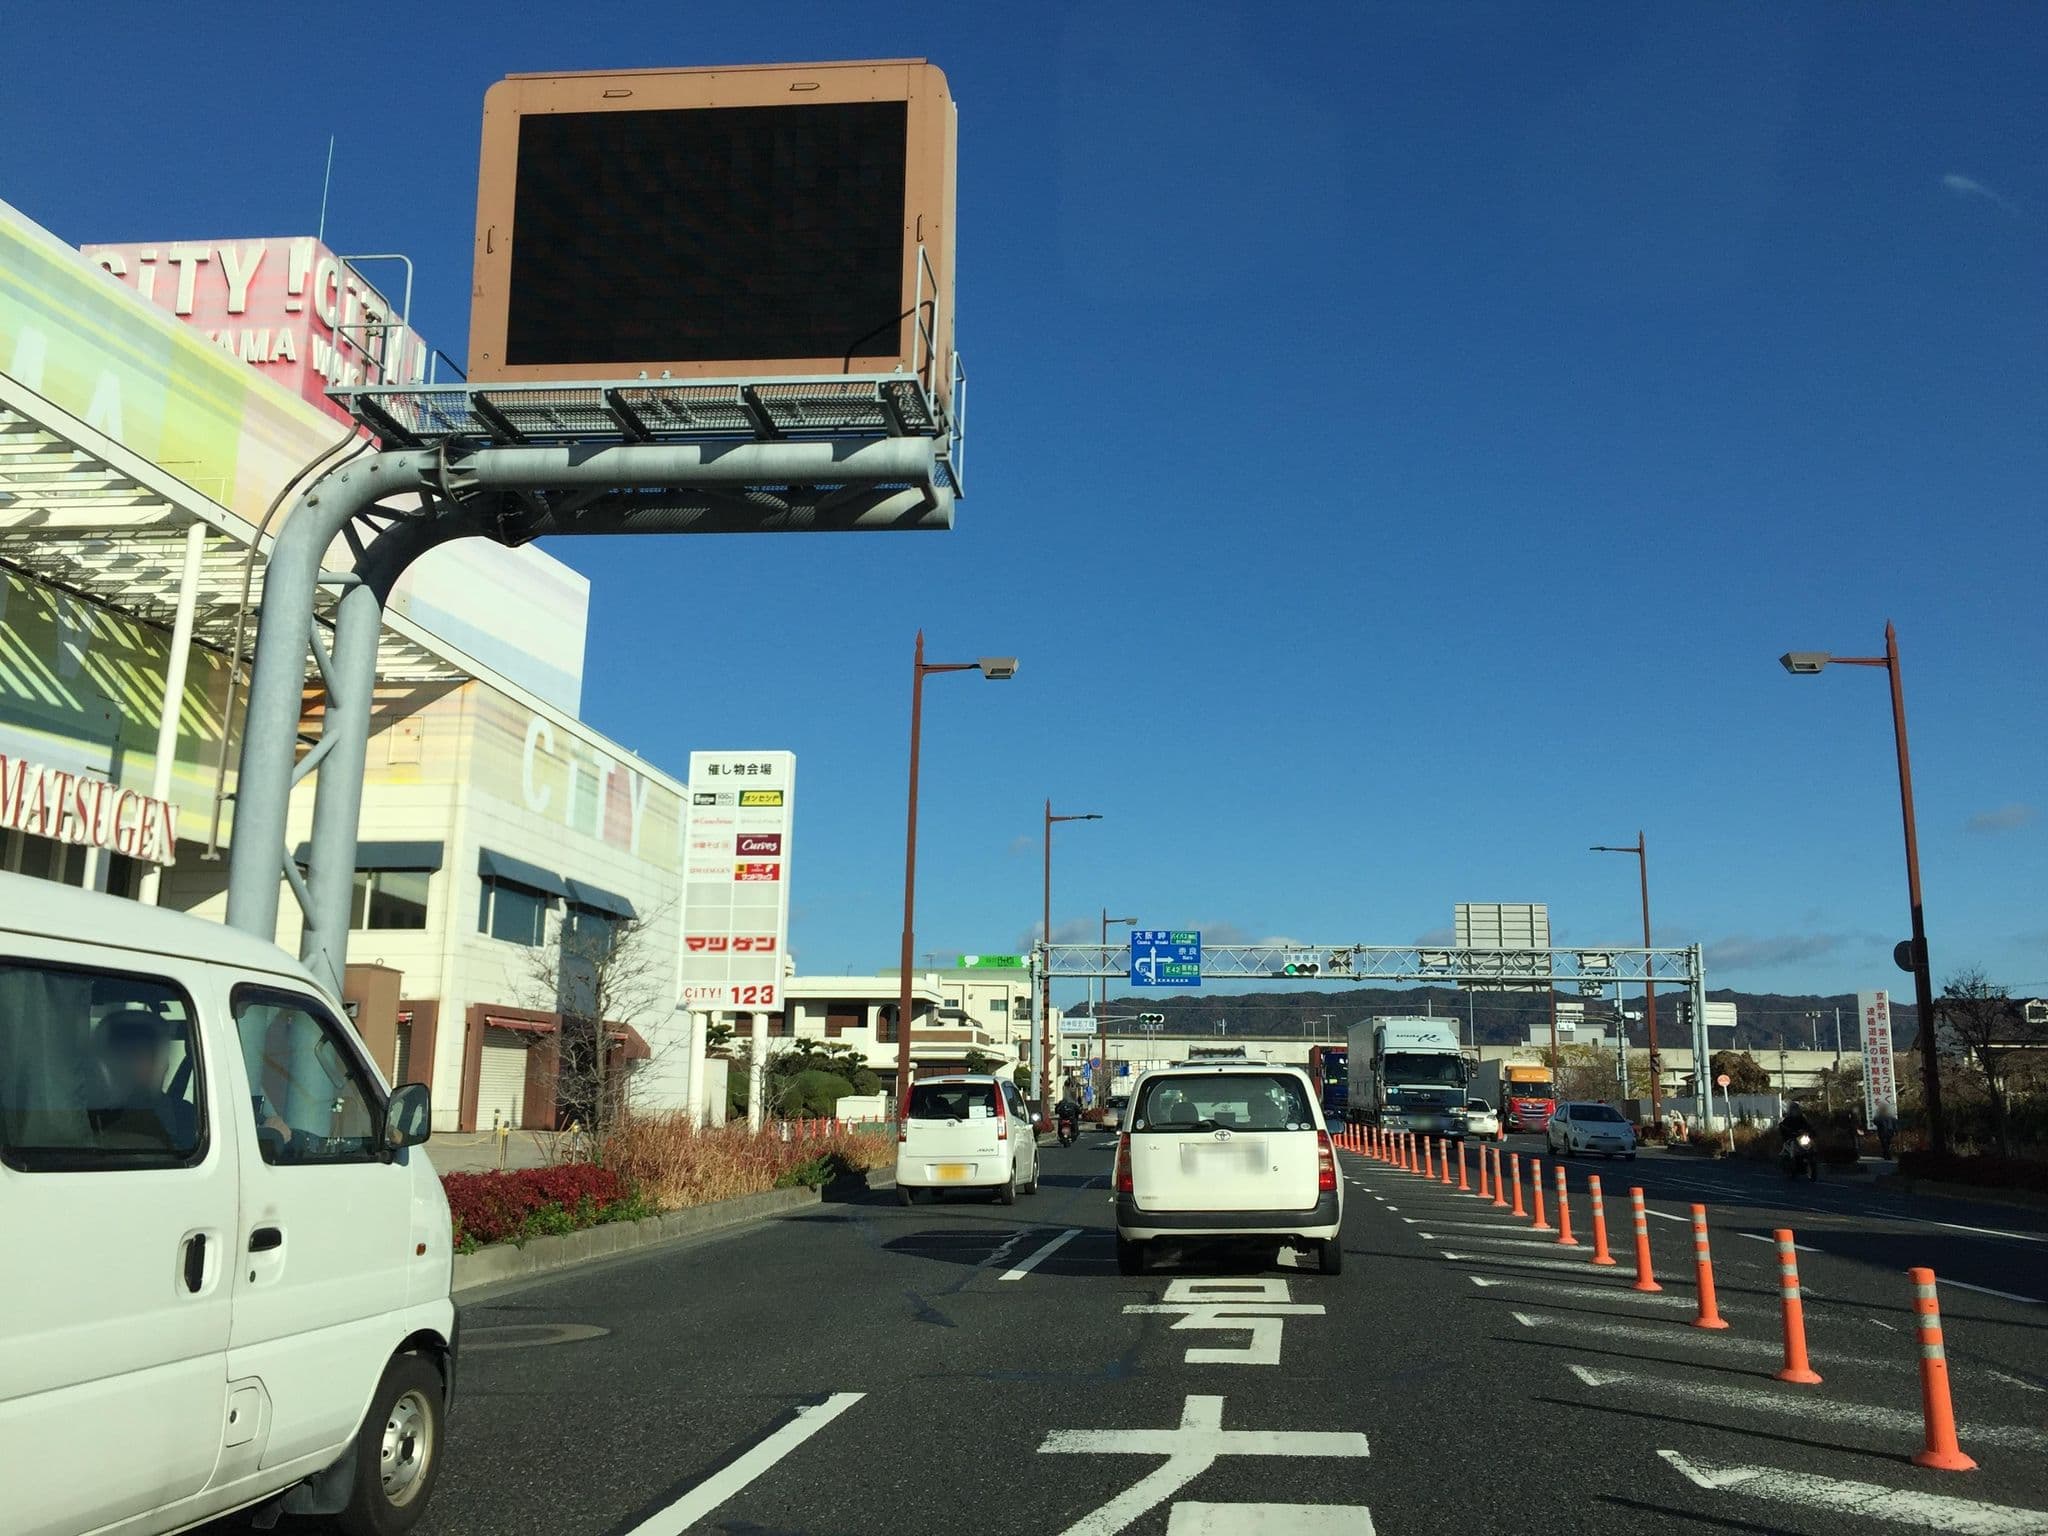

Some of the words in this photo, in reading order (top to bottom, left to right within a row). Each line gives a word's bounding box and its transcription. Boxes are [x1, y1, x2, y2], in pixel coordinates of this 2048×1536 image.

[708, 763, 772, 776] 催し物会場
[0, 754, 177, 864] MATSUGEN
[741, 839, 778, 852] Curves
[685, 936, 776, 952] マツゲン
[731, 984, 774, 1005] 123
